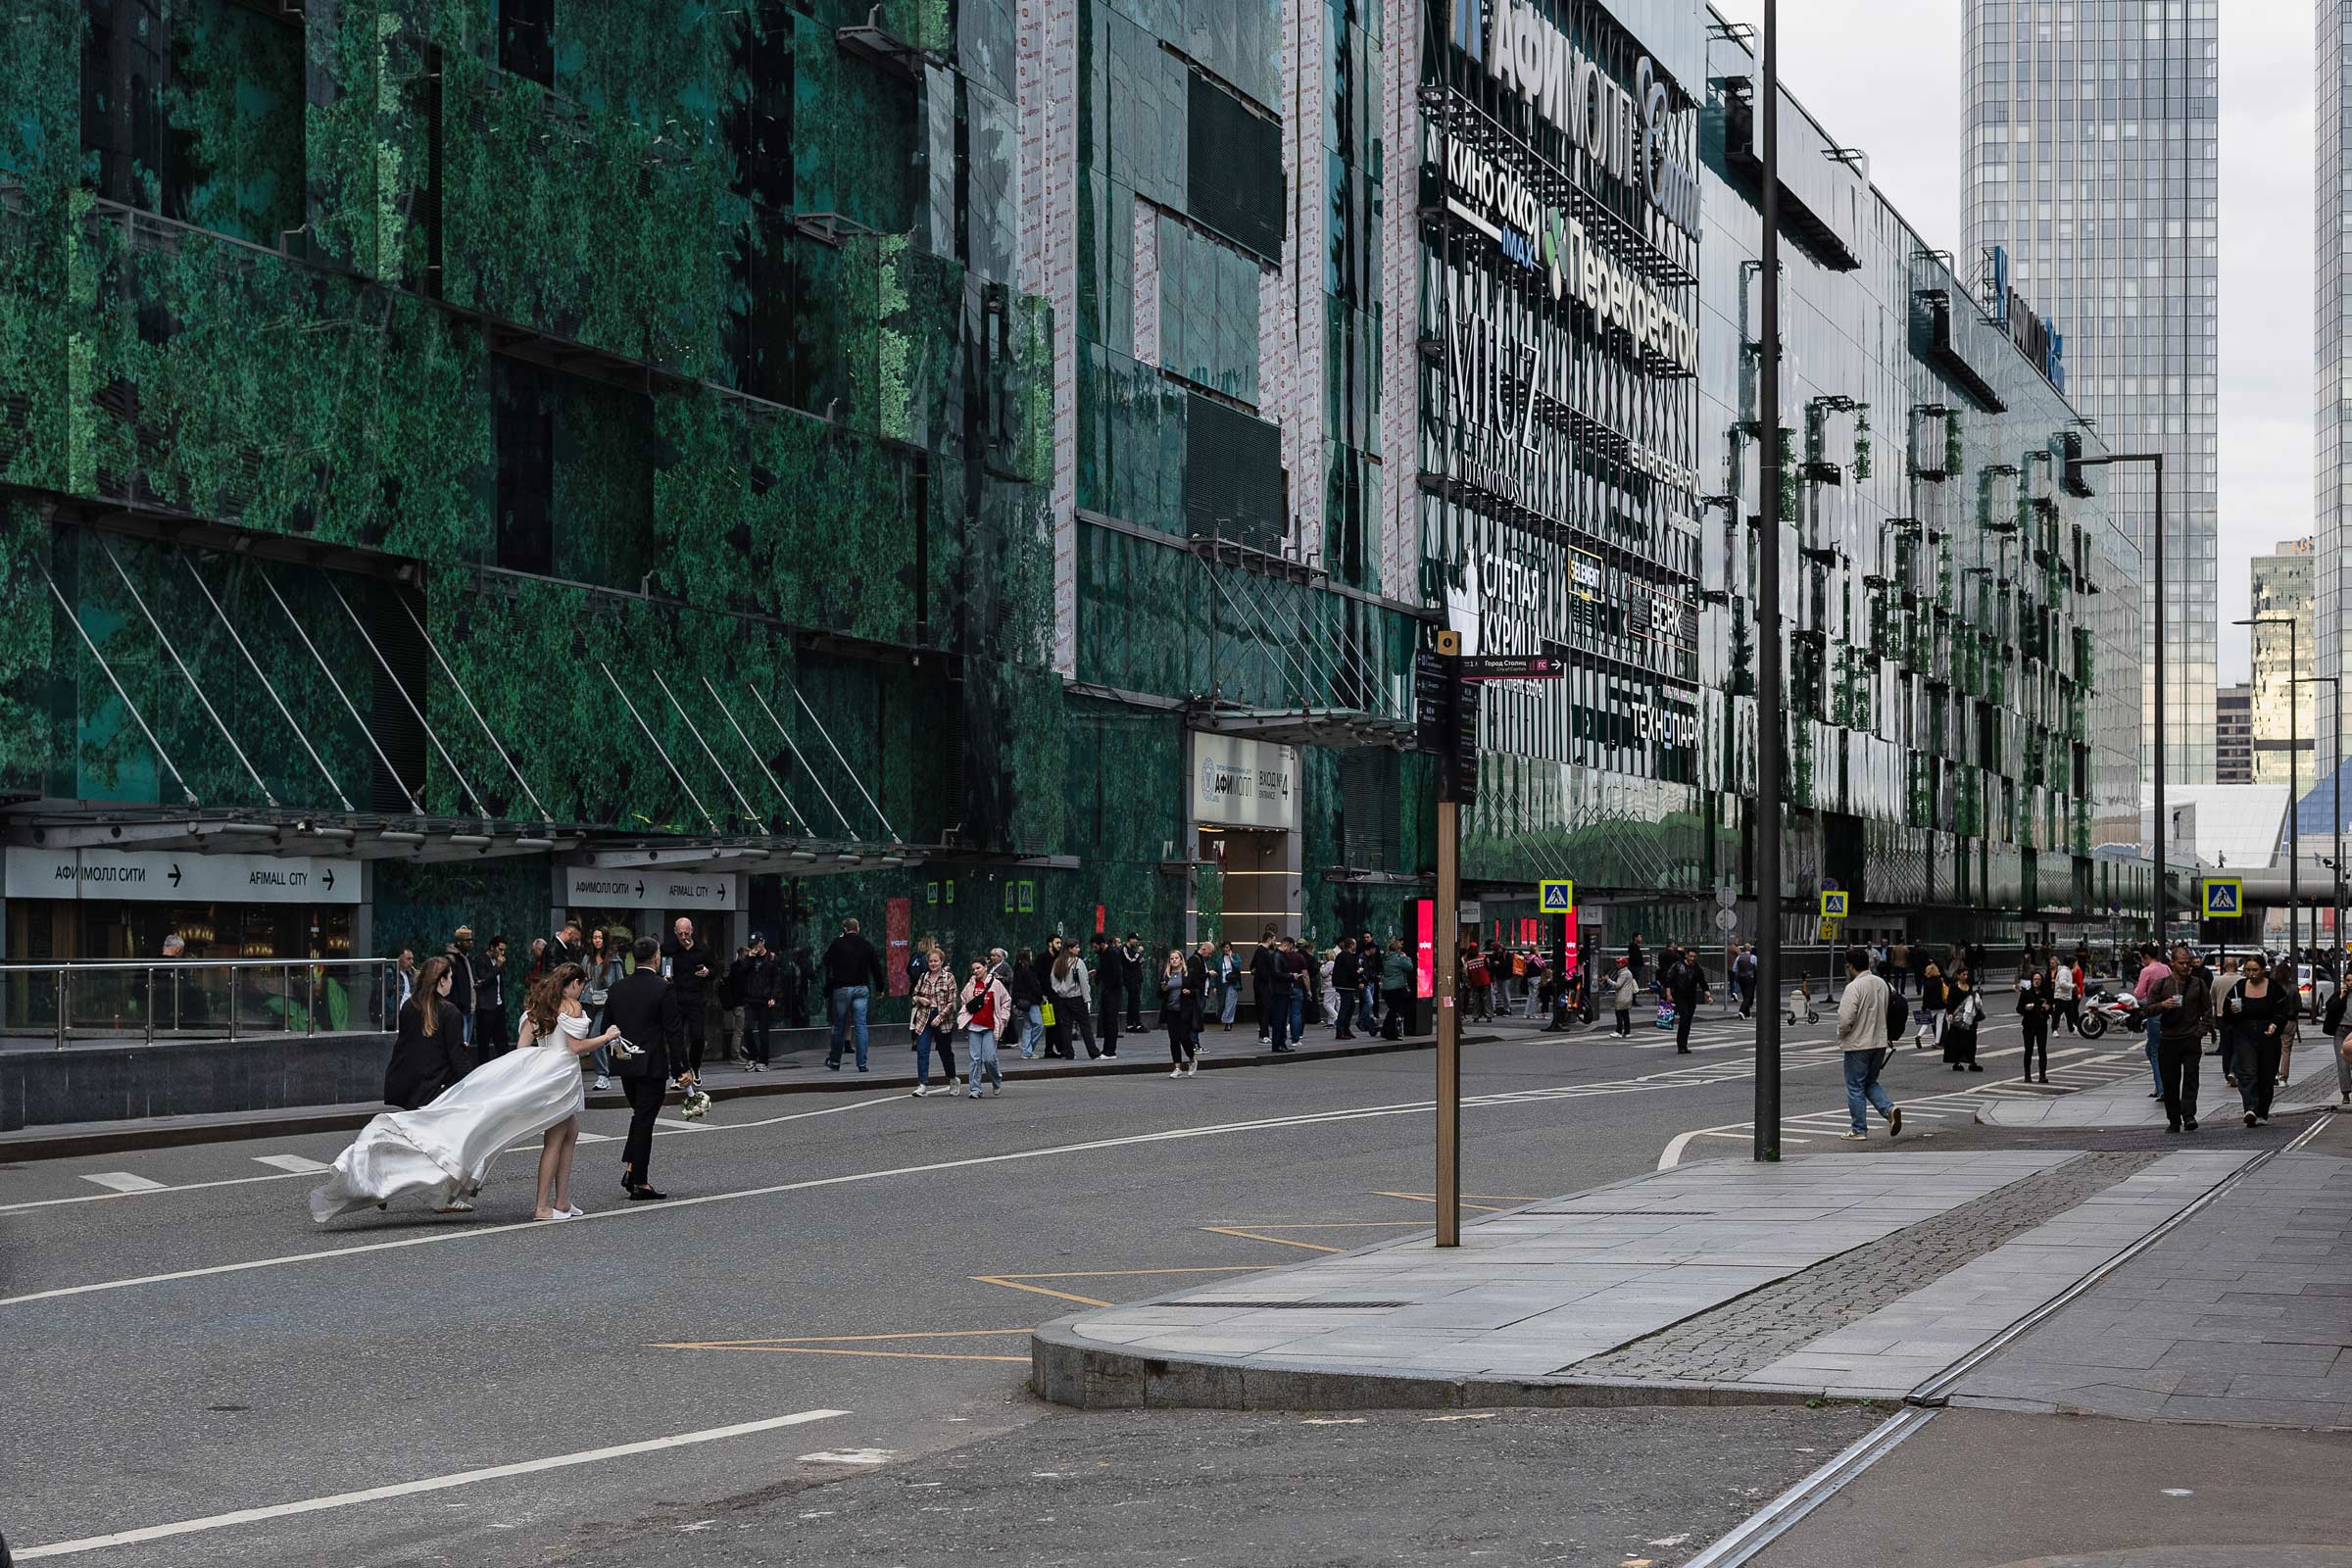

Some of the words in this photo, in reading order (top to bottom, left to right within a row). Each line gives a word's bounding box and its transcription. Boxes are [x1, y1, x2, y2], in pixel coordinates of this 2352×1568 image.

[1489, 0, 1633, 187] АФИМОЛЛ
[1447, 133, 1494, 207] КИНО
[1502, 224, 1534, 272] IMAX
[1568, 218, 1699, 378] Перекрёсток
[1464, 453, 1520, 503] DIAMONDS
[1628, 441, 1692, 495] EUROSPAR
[1483, 552, 1540, 612] СЛЕПАЯ
[1484, 610, 1542, 656] КУРИЦА
[1485, 660, 1503, 668] Город
[1631, 701, 1701, 751] ТЕХНОПАРК
[1215, 773, 1252, 797] АФИМОЛЛ
[1259, 770, 1276, 790] ВХОД
[1282, 773, 1289, 801] 4
[55, 865, 117, 882] АФИМОЛЛ
[119, 867, 146, 882] СИТИ
[249, 871, 285, 886] AFIMALL
[289, 872, 308, 886] CITY
[576, 883, 612, 895] АФИМОЛЛ
[612, 884, 630, 895] СИТИ
[669, 885, 695, 896] AFIMALL
[697, 886, 709, 896] CITY
